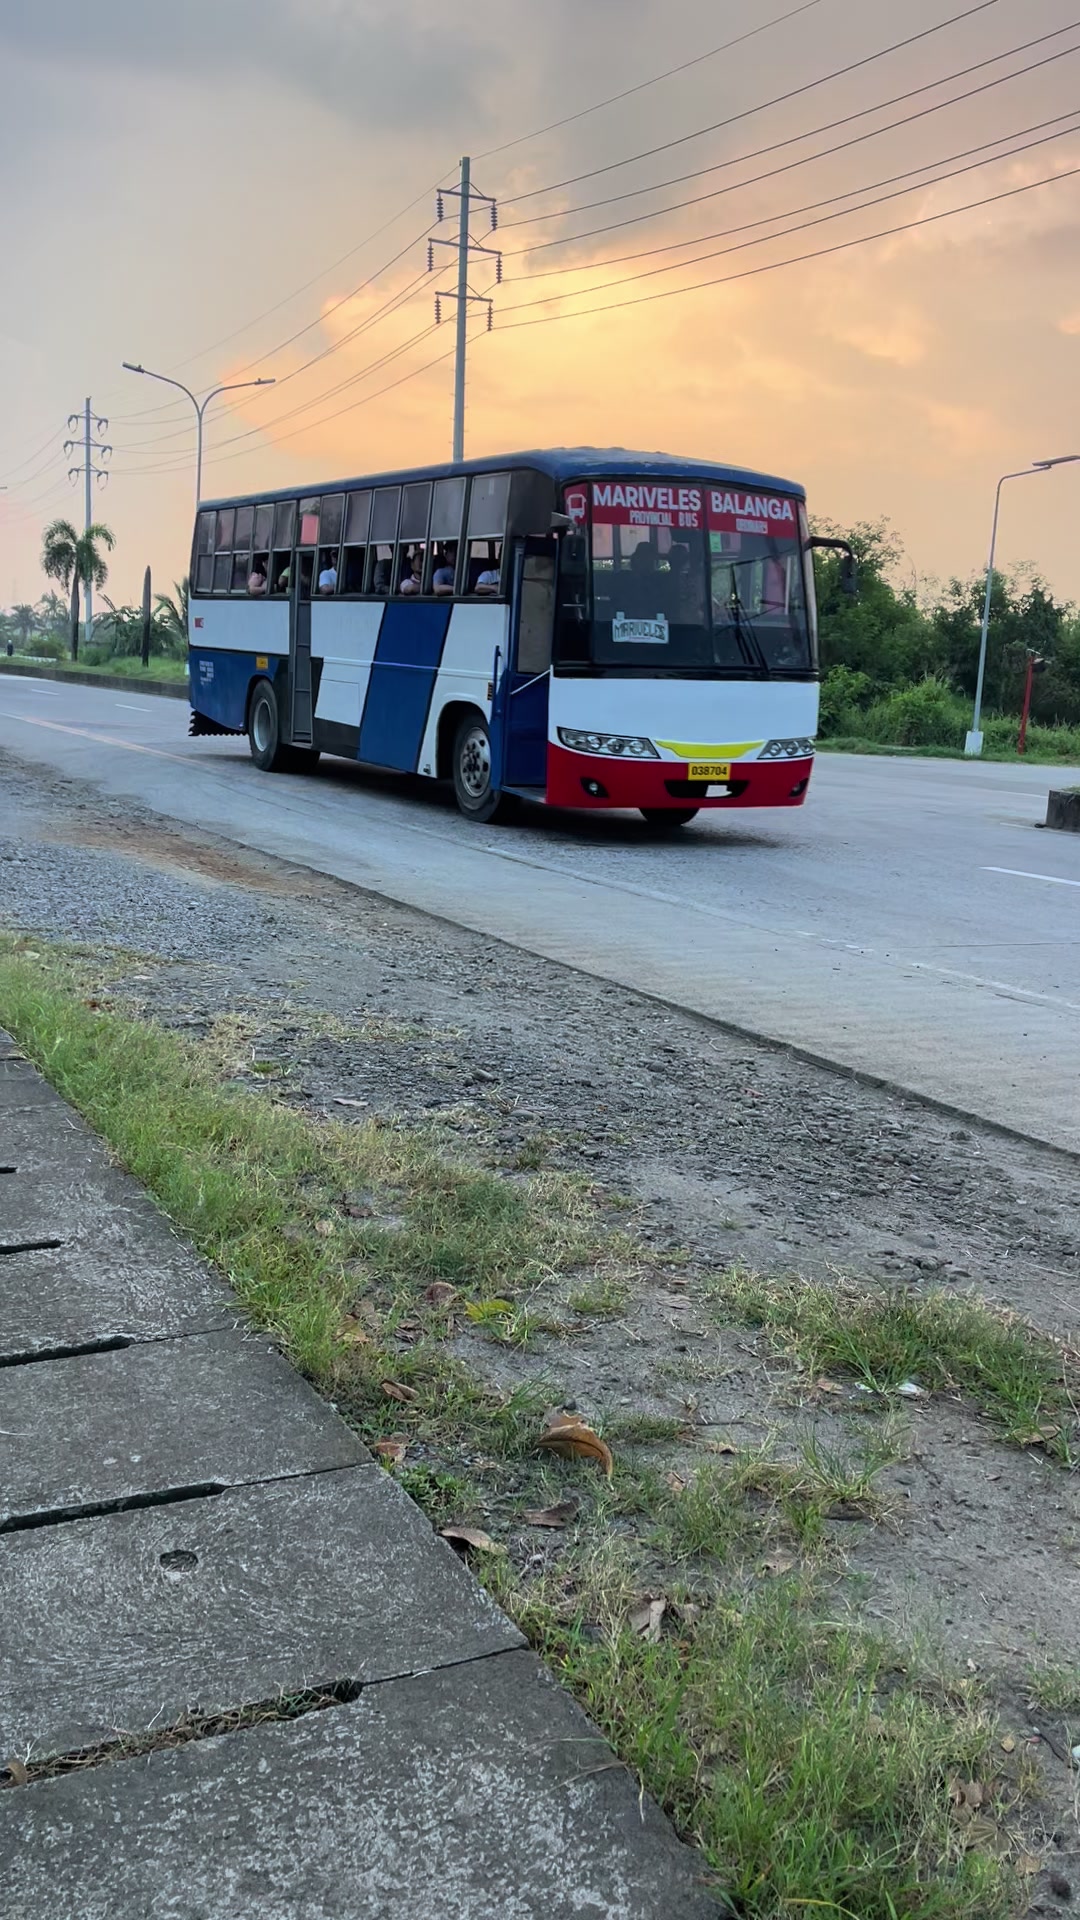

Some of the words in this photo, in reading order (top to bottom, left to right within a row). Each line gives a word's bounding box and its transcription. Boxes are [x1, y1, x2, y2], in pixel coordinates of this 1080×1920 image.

[592, 484, 702, 511] MARIVELES
[711, 491, 794, 521] BALANGA
[678, 511, 699, 528] BUS
